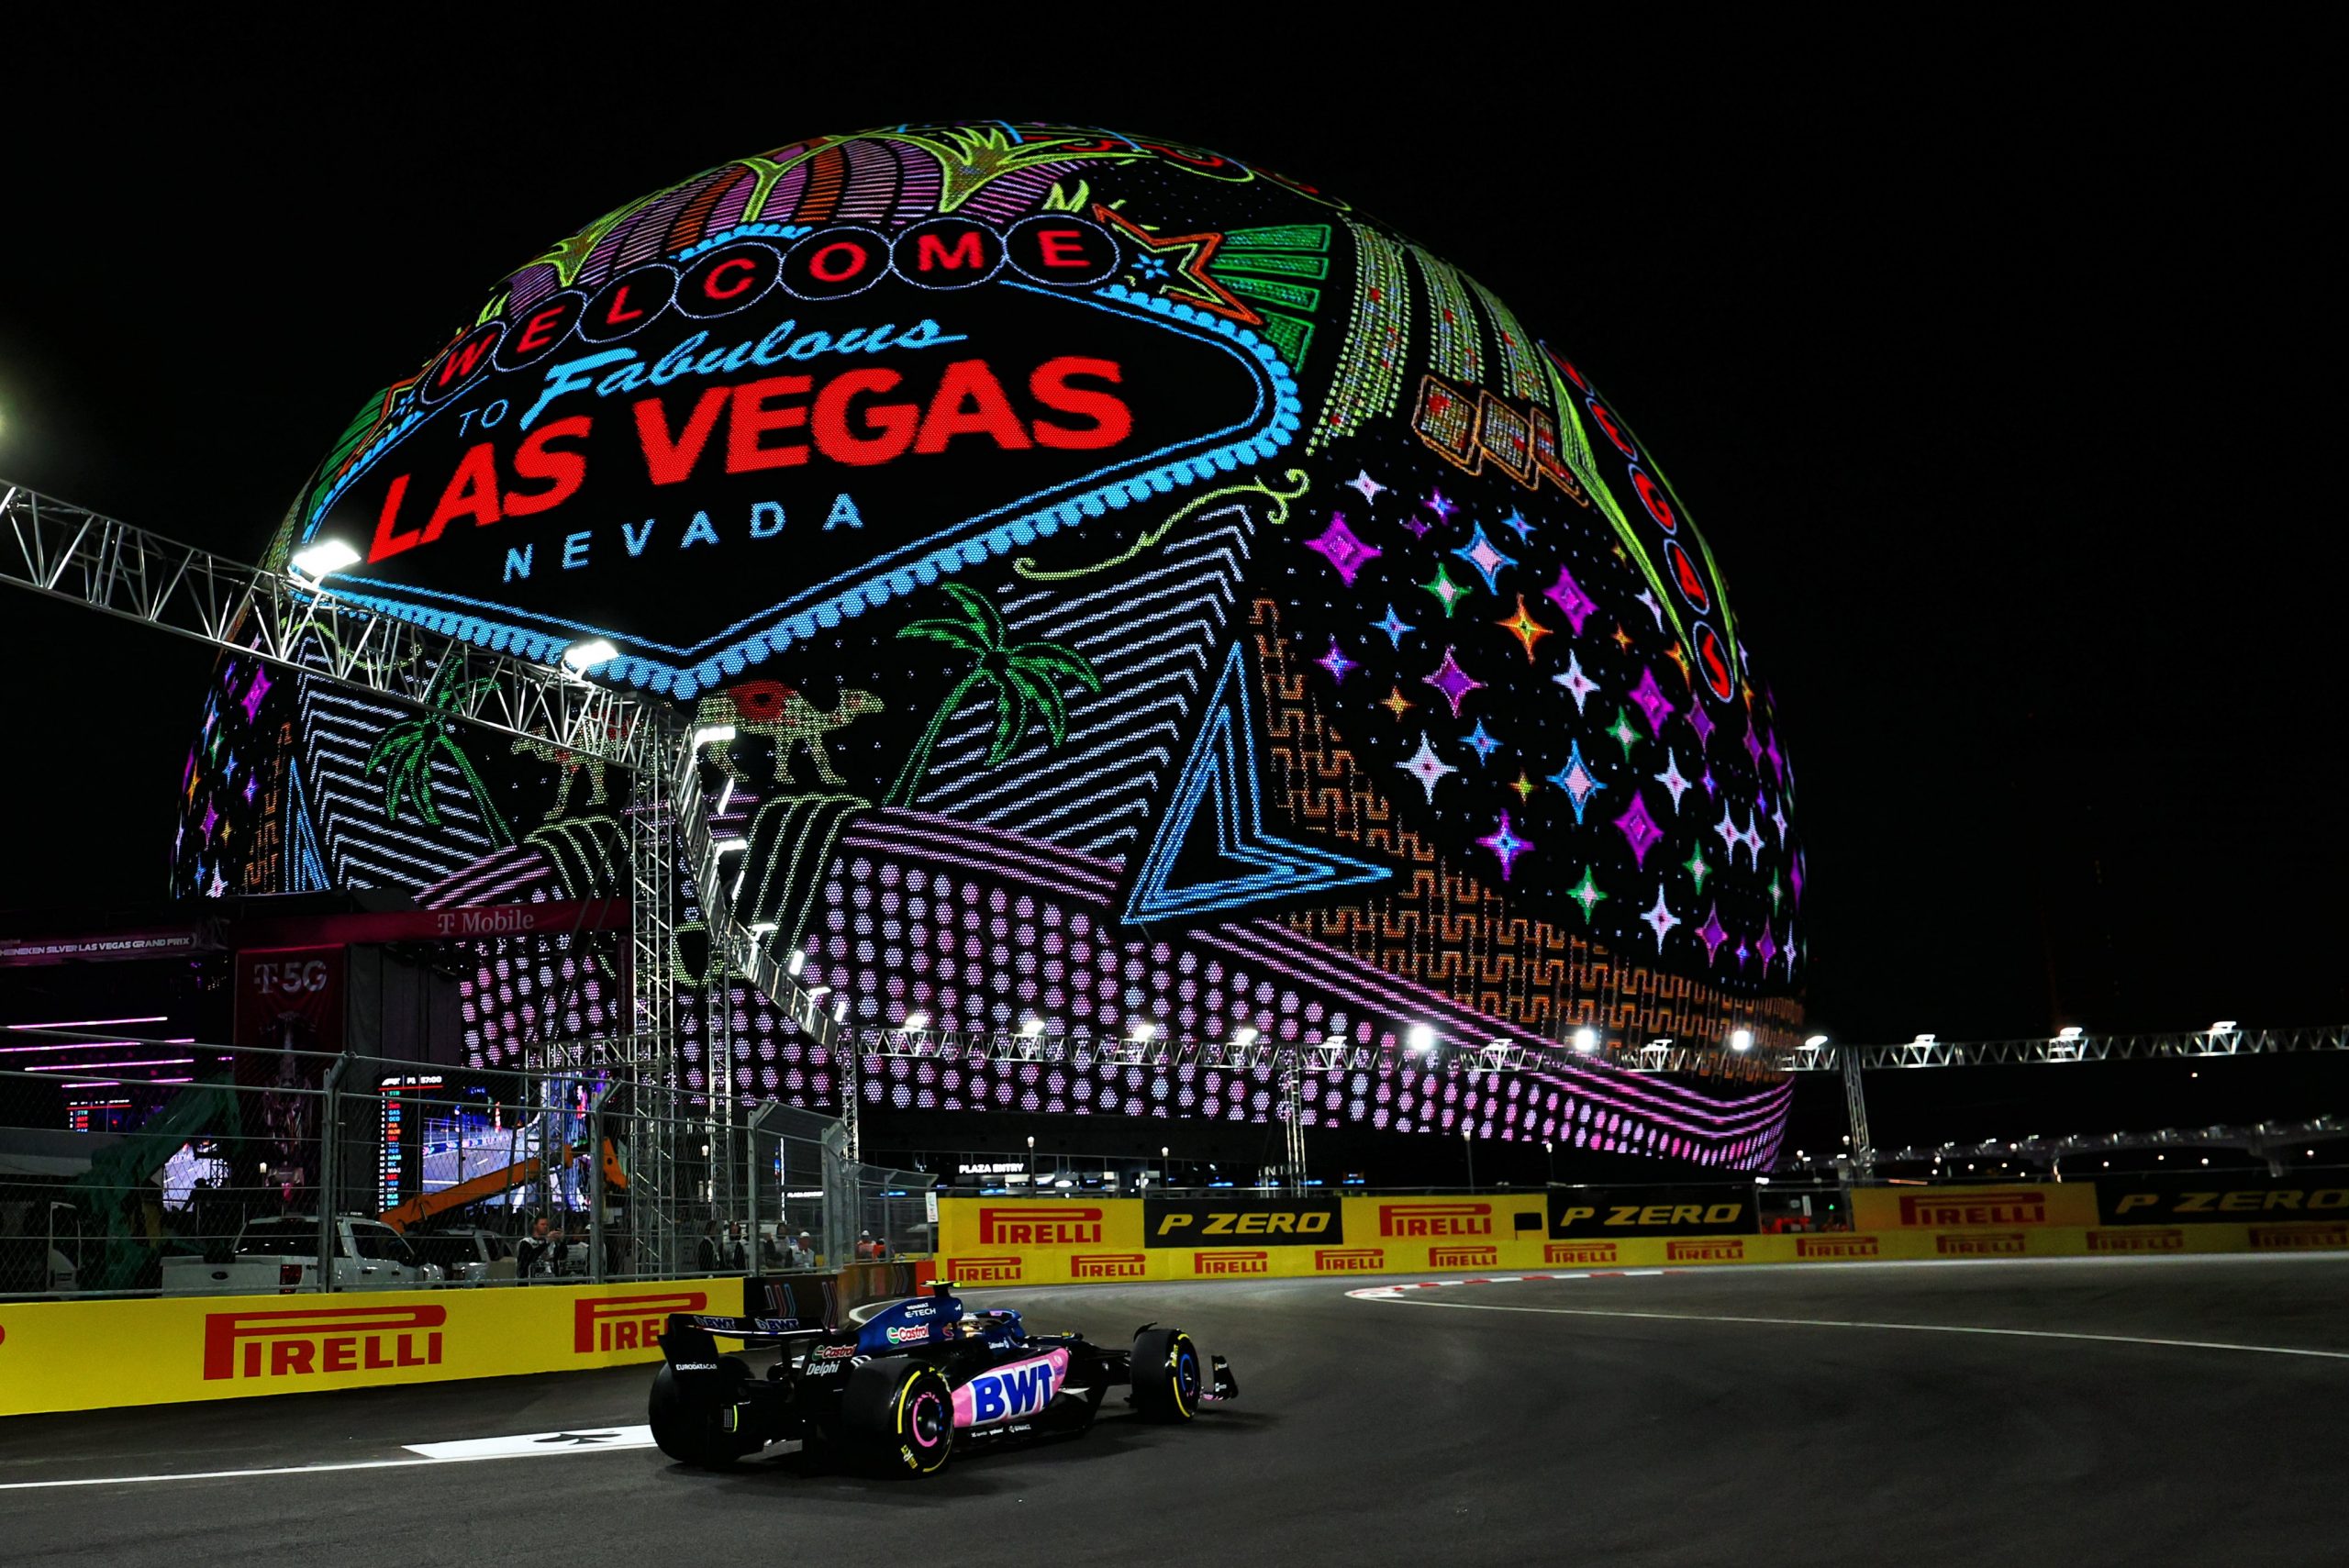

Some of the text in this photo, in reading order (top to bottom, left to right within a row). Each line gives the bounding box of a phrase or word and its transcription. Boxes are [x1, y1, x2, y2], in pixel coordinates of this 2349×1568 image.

[440, 231, 1090, 386] WELCOME
[458, 319, 968, 438] TO Fabulous
[367, 357, 1131, 563] LAS VEGAS
[504, 494, 863, 582] NEVADA
[462, 909, 535, 933] Mobile
[46, 945, 78, 953] SILVER
[79, 943, 97, 951] LAS
[99, 941, 131, 951] VEGAS
[132, 940, 166, 948] GRAND
[167, 938, 190, 946] PRIX
[282, 961, 327, 993] 5G
[959, 1162, 1024, 1173] PLAZA ENTRY
[1899, 1195, 2045, 1226] PIRELLI
[2116, 1189, 2349, 1215] P ZERO
[980, 1207, 1103, 1244] PIRELLI
[1157, 1212, 1331, 1235] P ZERO
[1379, 1204, 1492, 1237] PIRELLI
[1561, 1204, 1742, 1227] P ZERO
[1544, 1243, 1617, 1263] PIRELLI
[1667, 1240, 1743, 1261] PIRELLI
[1797, 1237, 1878, 1258] PIRELLI
[1936, 1234, 2025, 1253] PIRELLI
[1071, 1254, 1145, 1277] PIRELLI
[1195, 1251, 1267, 1274] PIRELLI
[1315, 1249, 1384, 1271] PIRELLI
[1429, 1246, 1497, 1267] PIRELLI
[948, 1256, 1021, 1282] PIRELLI
[574, 1292, 707, 1353] PIRE
[704, 1317, 735, 1329] BWT
[766, 1318, 799, 1330] BWT
[904, 1307, 937, 1318] E-TECH
[204, 1305, 447, 1381] PIRELLI
[898, 1323, 930, 1342] Castrol
[821, 1343, 858, 1359] Castrol
[806, 1360, 841, 1376] Delphi
[971, 1362, 1054, 1423] BWT
